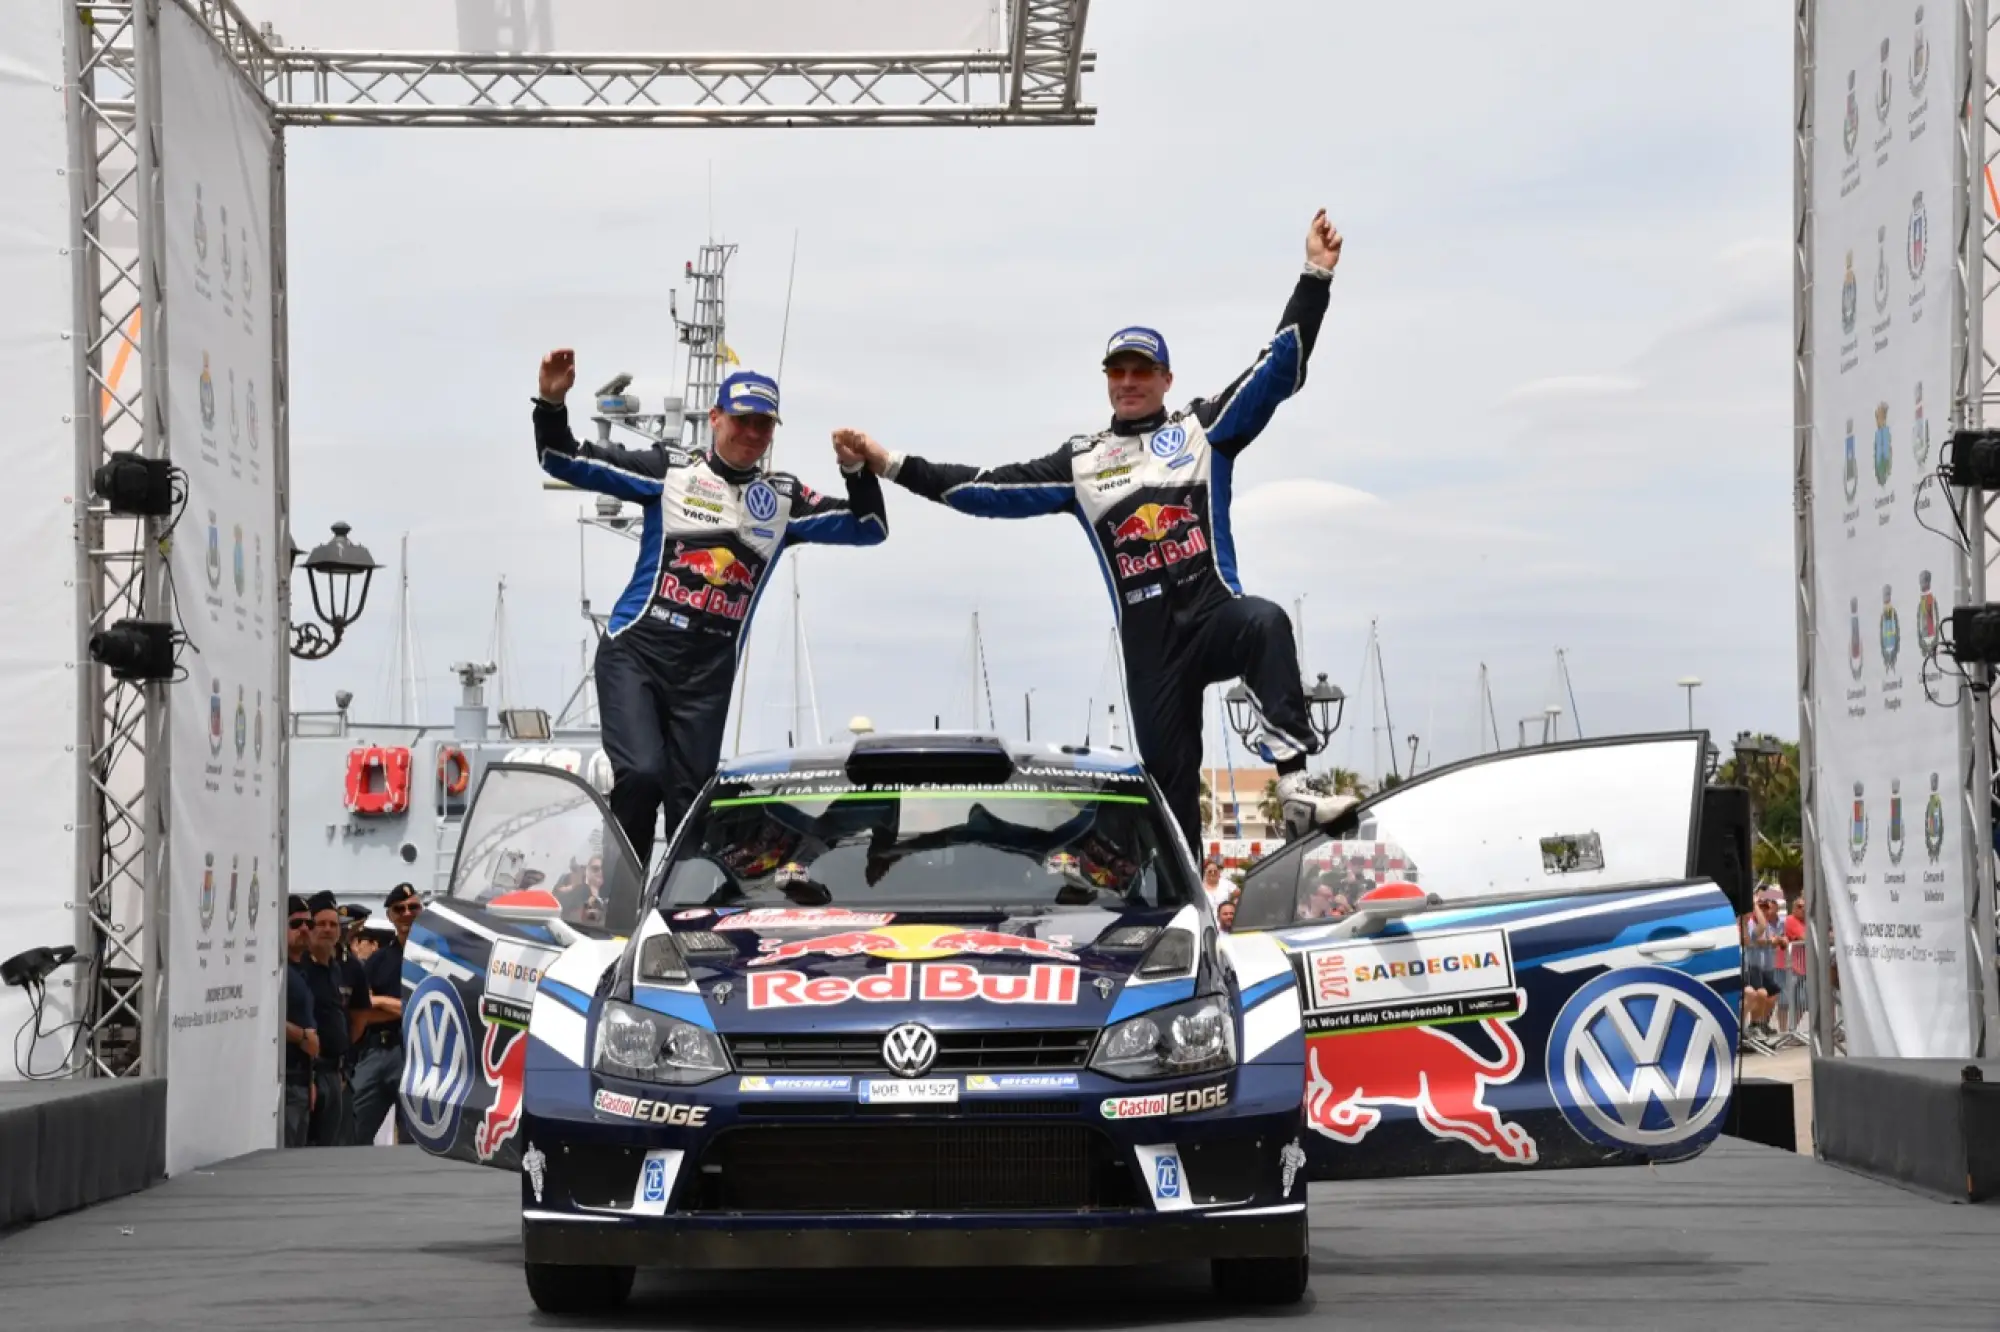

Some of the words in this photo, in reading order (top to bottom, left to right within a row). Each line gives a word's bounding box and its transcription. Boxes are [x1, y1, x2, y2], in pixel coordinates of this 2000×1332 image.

[1116, 542, 1163, 579] Red
[1160, 526, 1208, 566] Bull
[659, 572, 711, 610] Red
[706, 588, 749, 620] Bull
[719, 769, 842, 785] Volkswagen
[1016, 766, 1145, 783] Volkswagen
[785, 786, 812, 795] FIA
[818, 783, 867, 793] World
[872, 783, 914, 792] Rally
[919, 782, 1038, 792] Championship
[1317, 954, 1349, 1001] 2016
[1354, 951, 1500, 982] SARDEGNA
[747, 964, 911, 1010] Red
[919, 962, 1080, 1005] Bull
[1320, 1015, 1350, 1027] World
[1353, 1013, 1379, 1025] Rally
[1382, 1004, 1454, 1021] Championship
[772, 1076, 848, 1089] MICHELIN
[871, 1083, 899, 1097] WOB
[908, 1083, 926, 1097] VW
[928, 1083, 956, 1097] 527
[1000, 1075, 1075, 1086] MICHELIN
[601, 1092, 632, 1114] Castrol
[634, 1099, 712, 1127] EDGE
[1118, 1098, 1165, 1116] Castrol
[1169, 1083, 1229, 1114] EDGE
